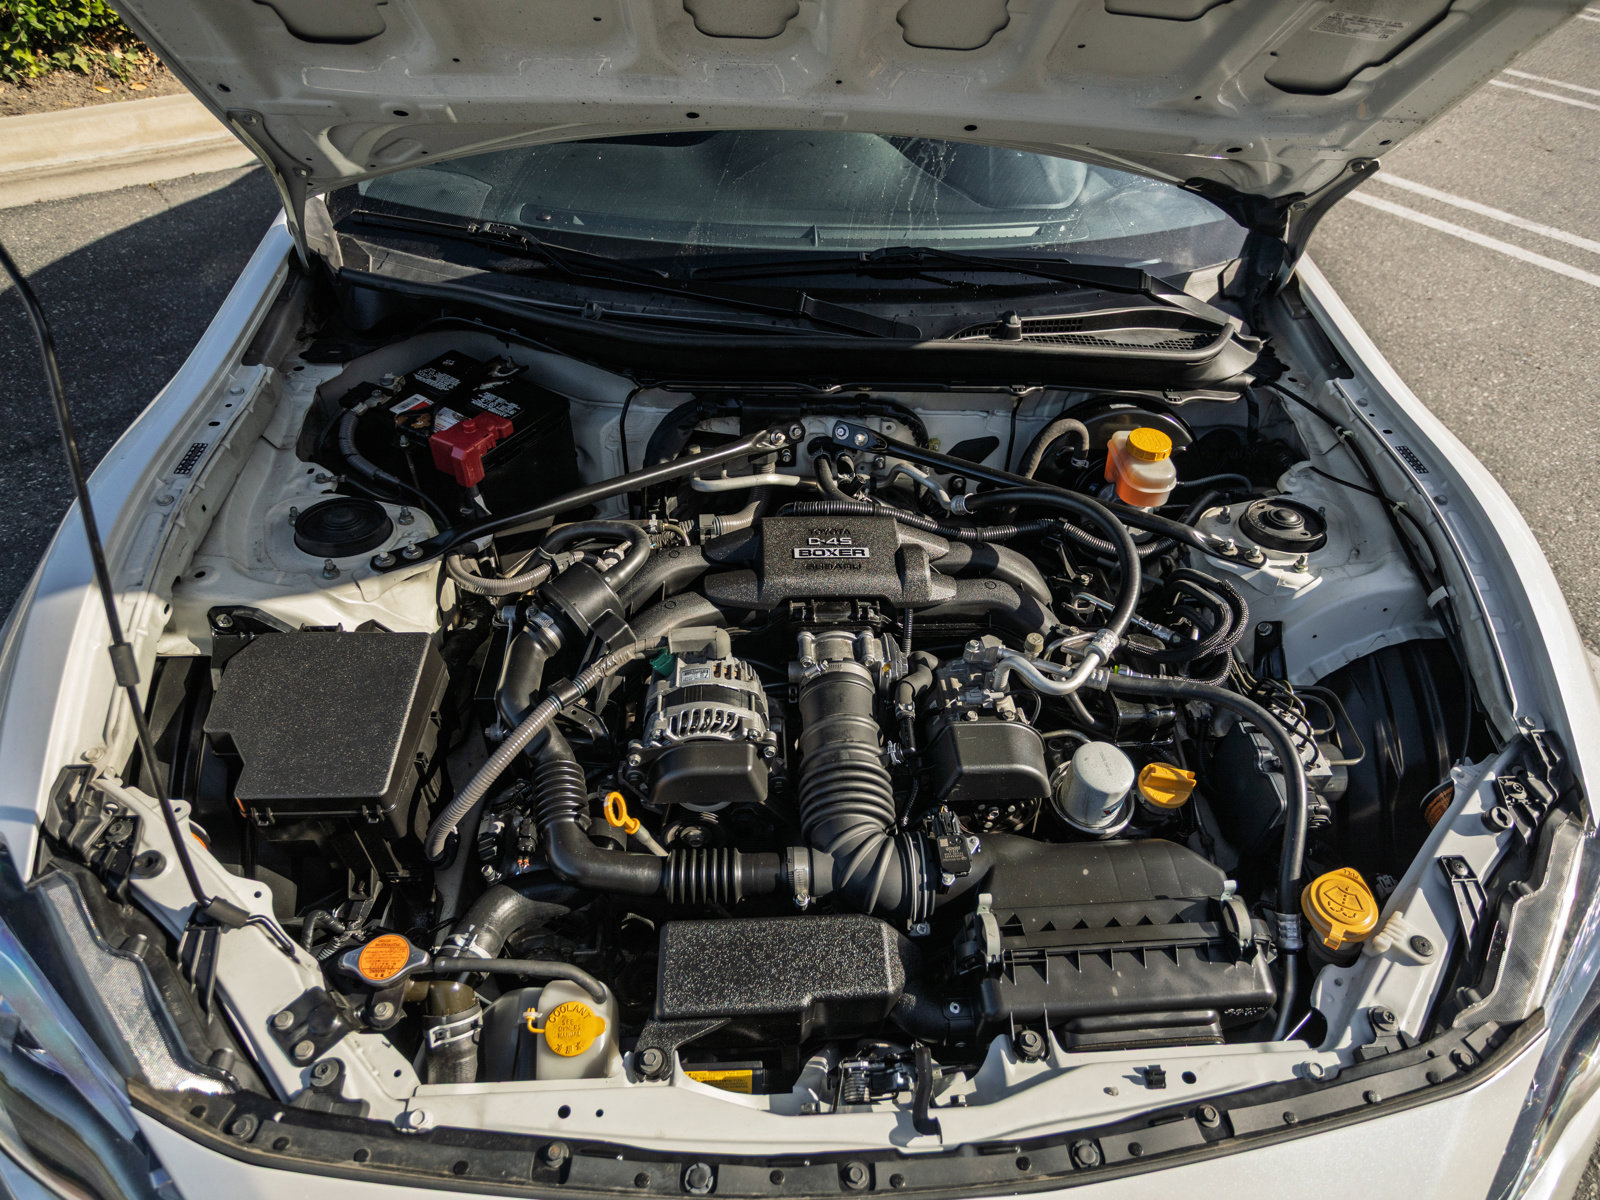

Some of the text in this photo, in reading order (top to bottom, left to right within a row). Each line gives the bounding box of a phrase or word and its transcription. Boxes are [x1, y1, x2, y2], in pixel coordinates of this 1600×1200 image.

[808, 528, 851, 536] TOYOTA
[807, 537, 852, 545] D-4S
[798, 548, 866, 557] BOXER
[548, 1004, 592, 1023] COOLANT
